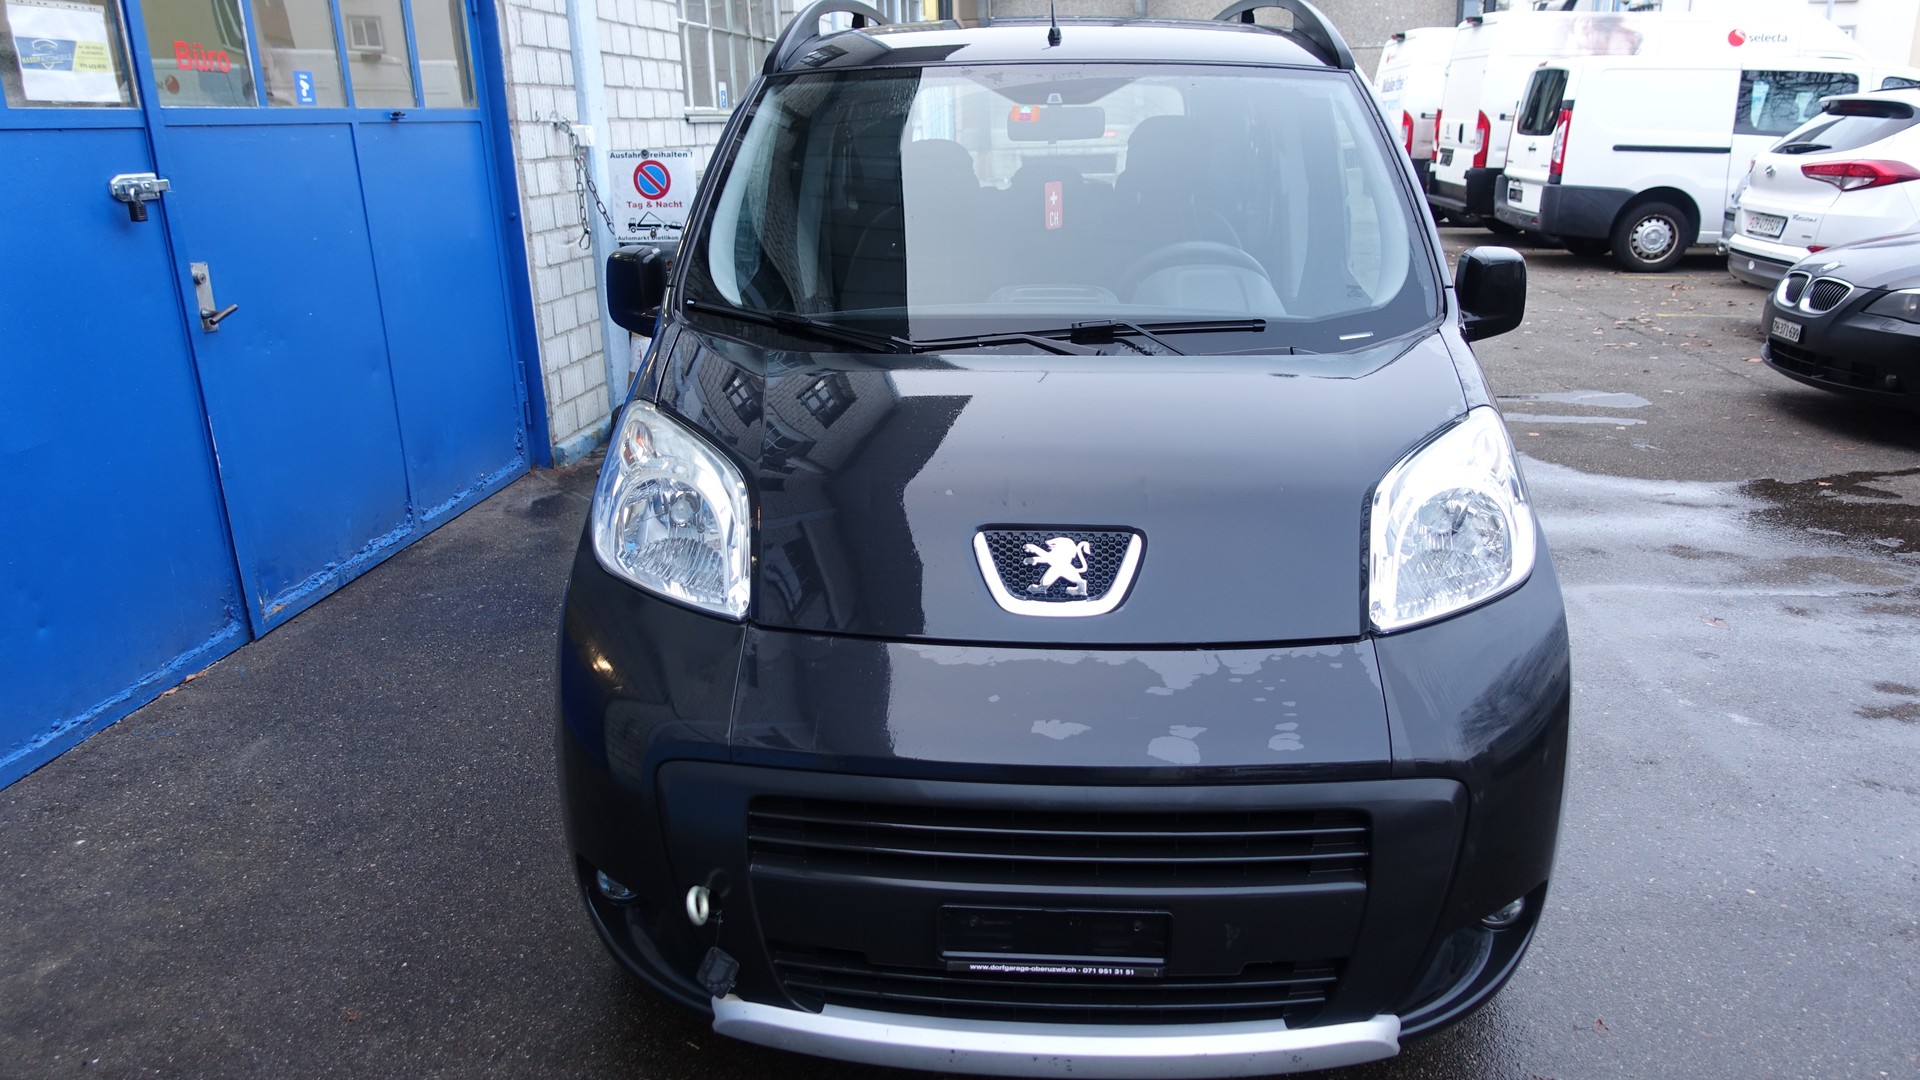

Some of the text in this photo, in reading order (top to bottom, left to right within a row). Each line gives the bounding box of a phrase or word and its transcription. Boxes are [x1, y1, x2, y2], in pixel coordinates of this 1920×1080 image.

[1749, 33, 1788, 42] selecta
[173, 40, 231, 73] Büro
[610, 151, 644, 159] Ausfahr
[645, 150, 688, 158] reihalten
[627, 201, 643, 210] Tag
[1049, 211, 1059, 226] CH
